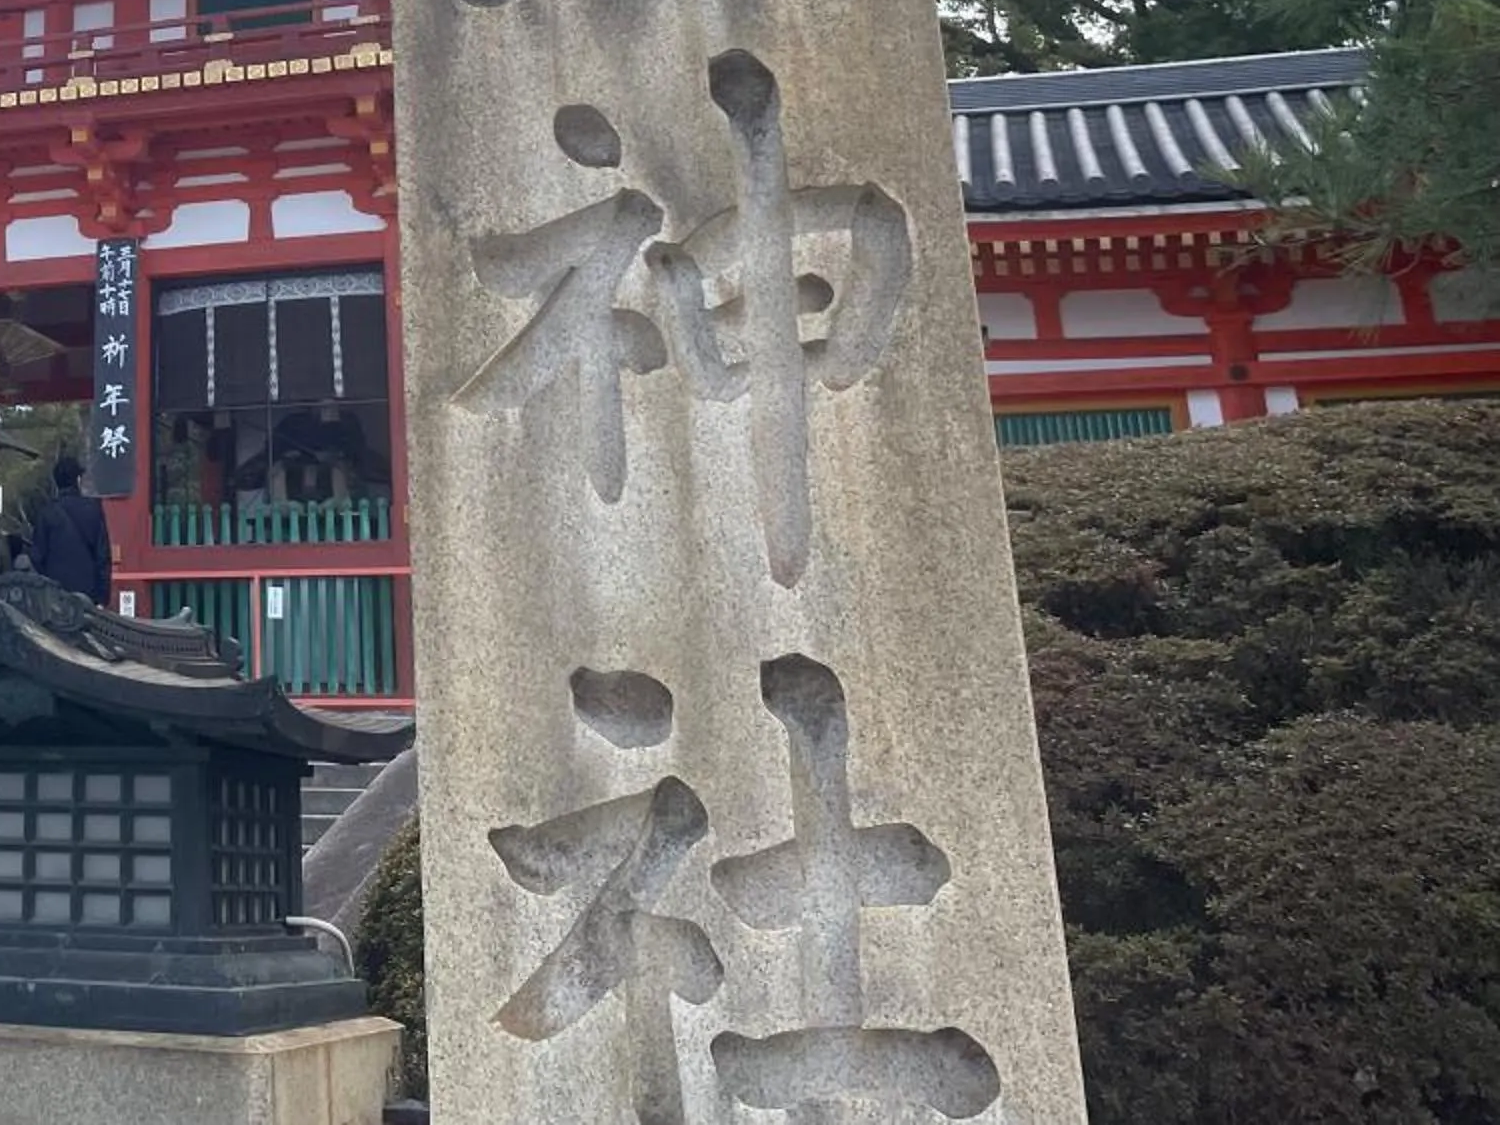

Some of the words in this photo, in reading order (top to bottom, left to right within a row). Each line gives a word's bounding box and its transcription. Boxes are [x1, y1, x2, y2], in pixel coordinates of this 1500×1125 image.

[98, 242, 117, 317] 午前十時
[116, 244, 137, 316] 三月十七日
[98, 334, 131, 458] 祈年祭
